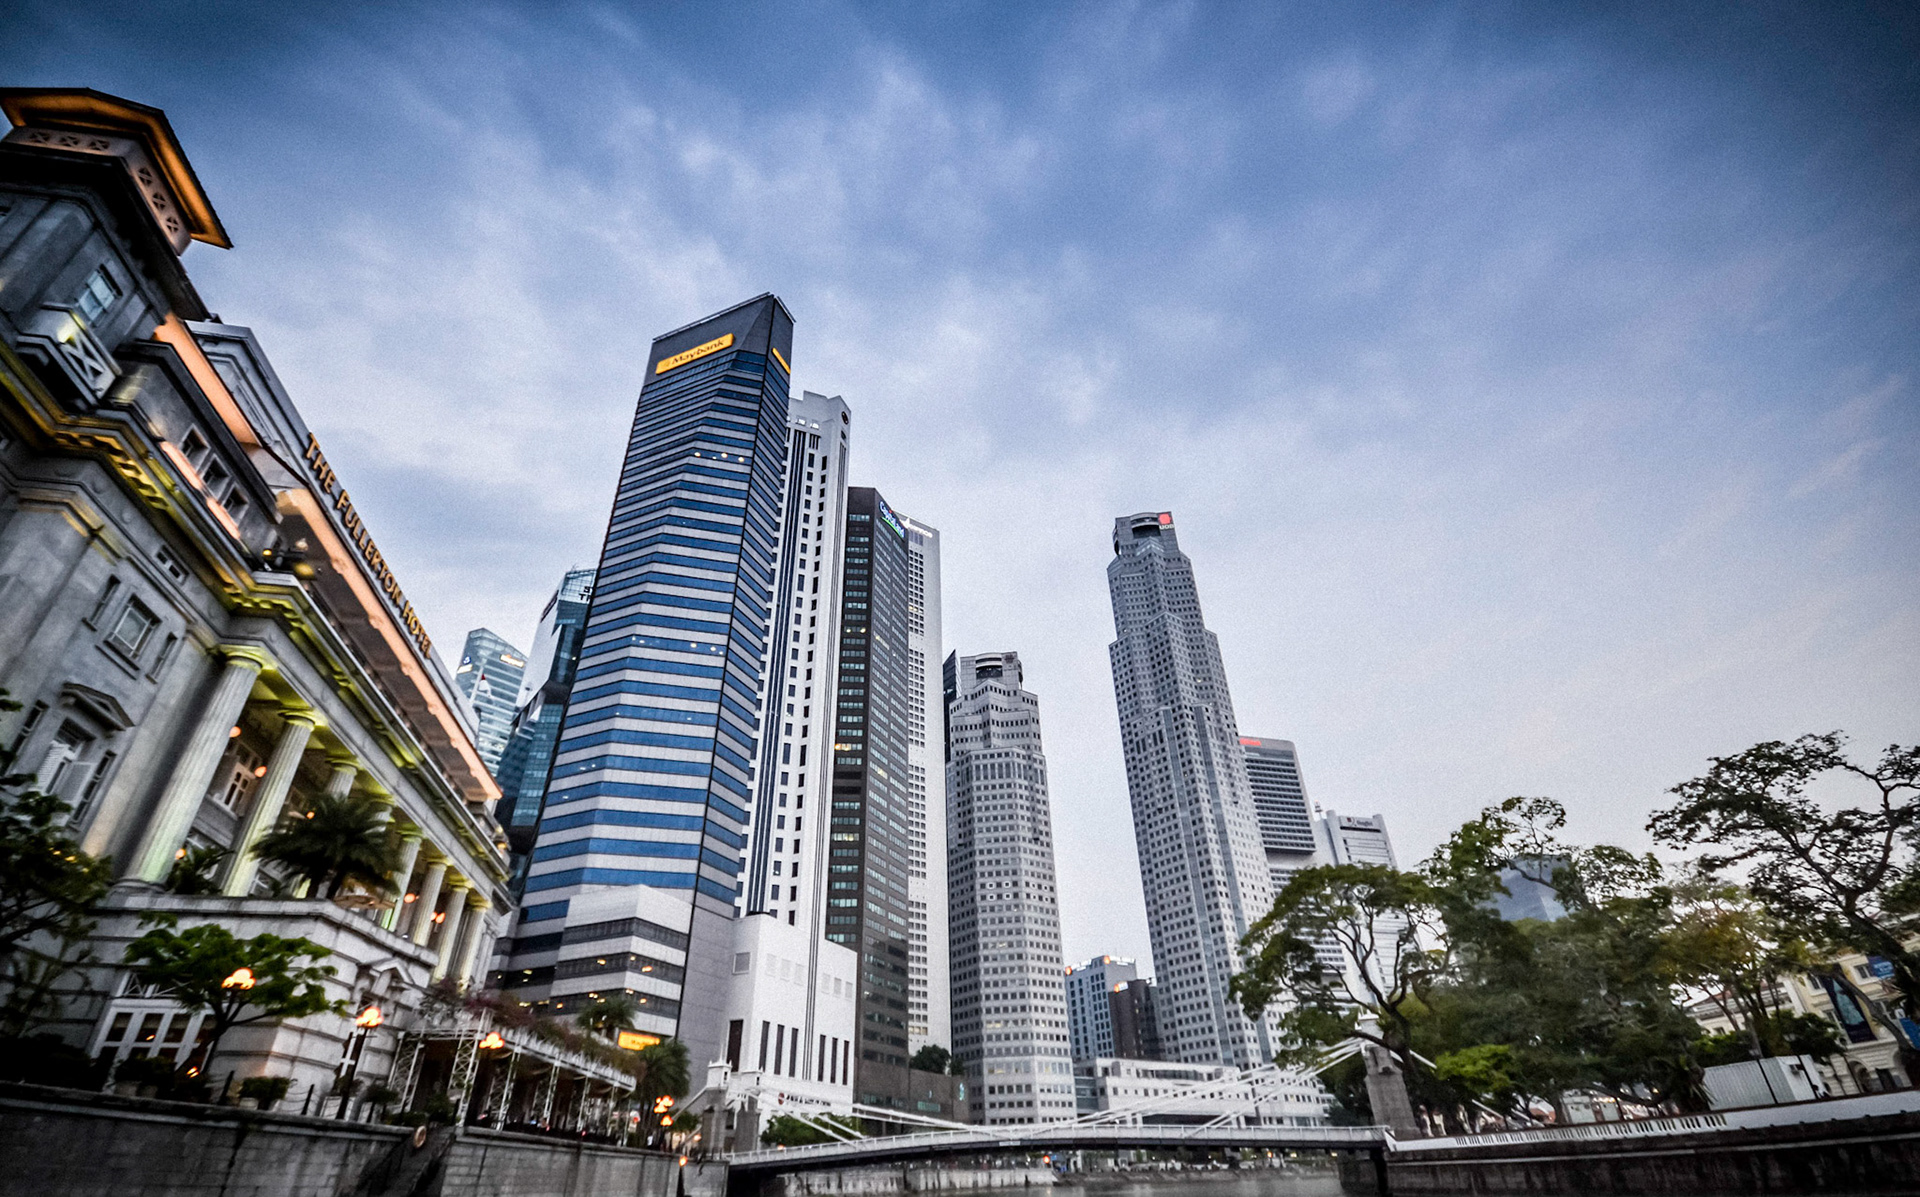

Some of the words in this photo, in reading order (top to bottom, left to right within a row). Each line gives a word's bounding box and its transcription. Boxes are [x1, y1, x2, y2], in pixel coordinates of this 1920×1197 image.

[672, 340, 724, 364] Maybank
[306, 432, 336, 494] THE
[336, 489, 402, 606] FULLERTON
[402, 599, 431, 659] HOTEL
